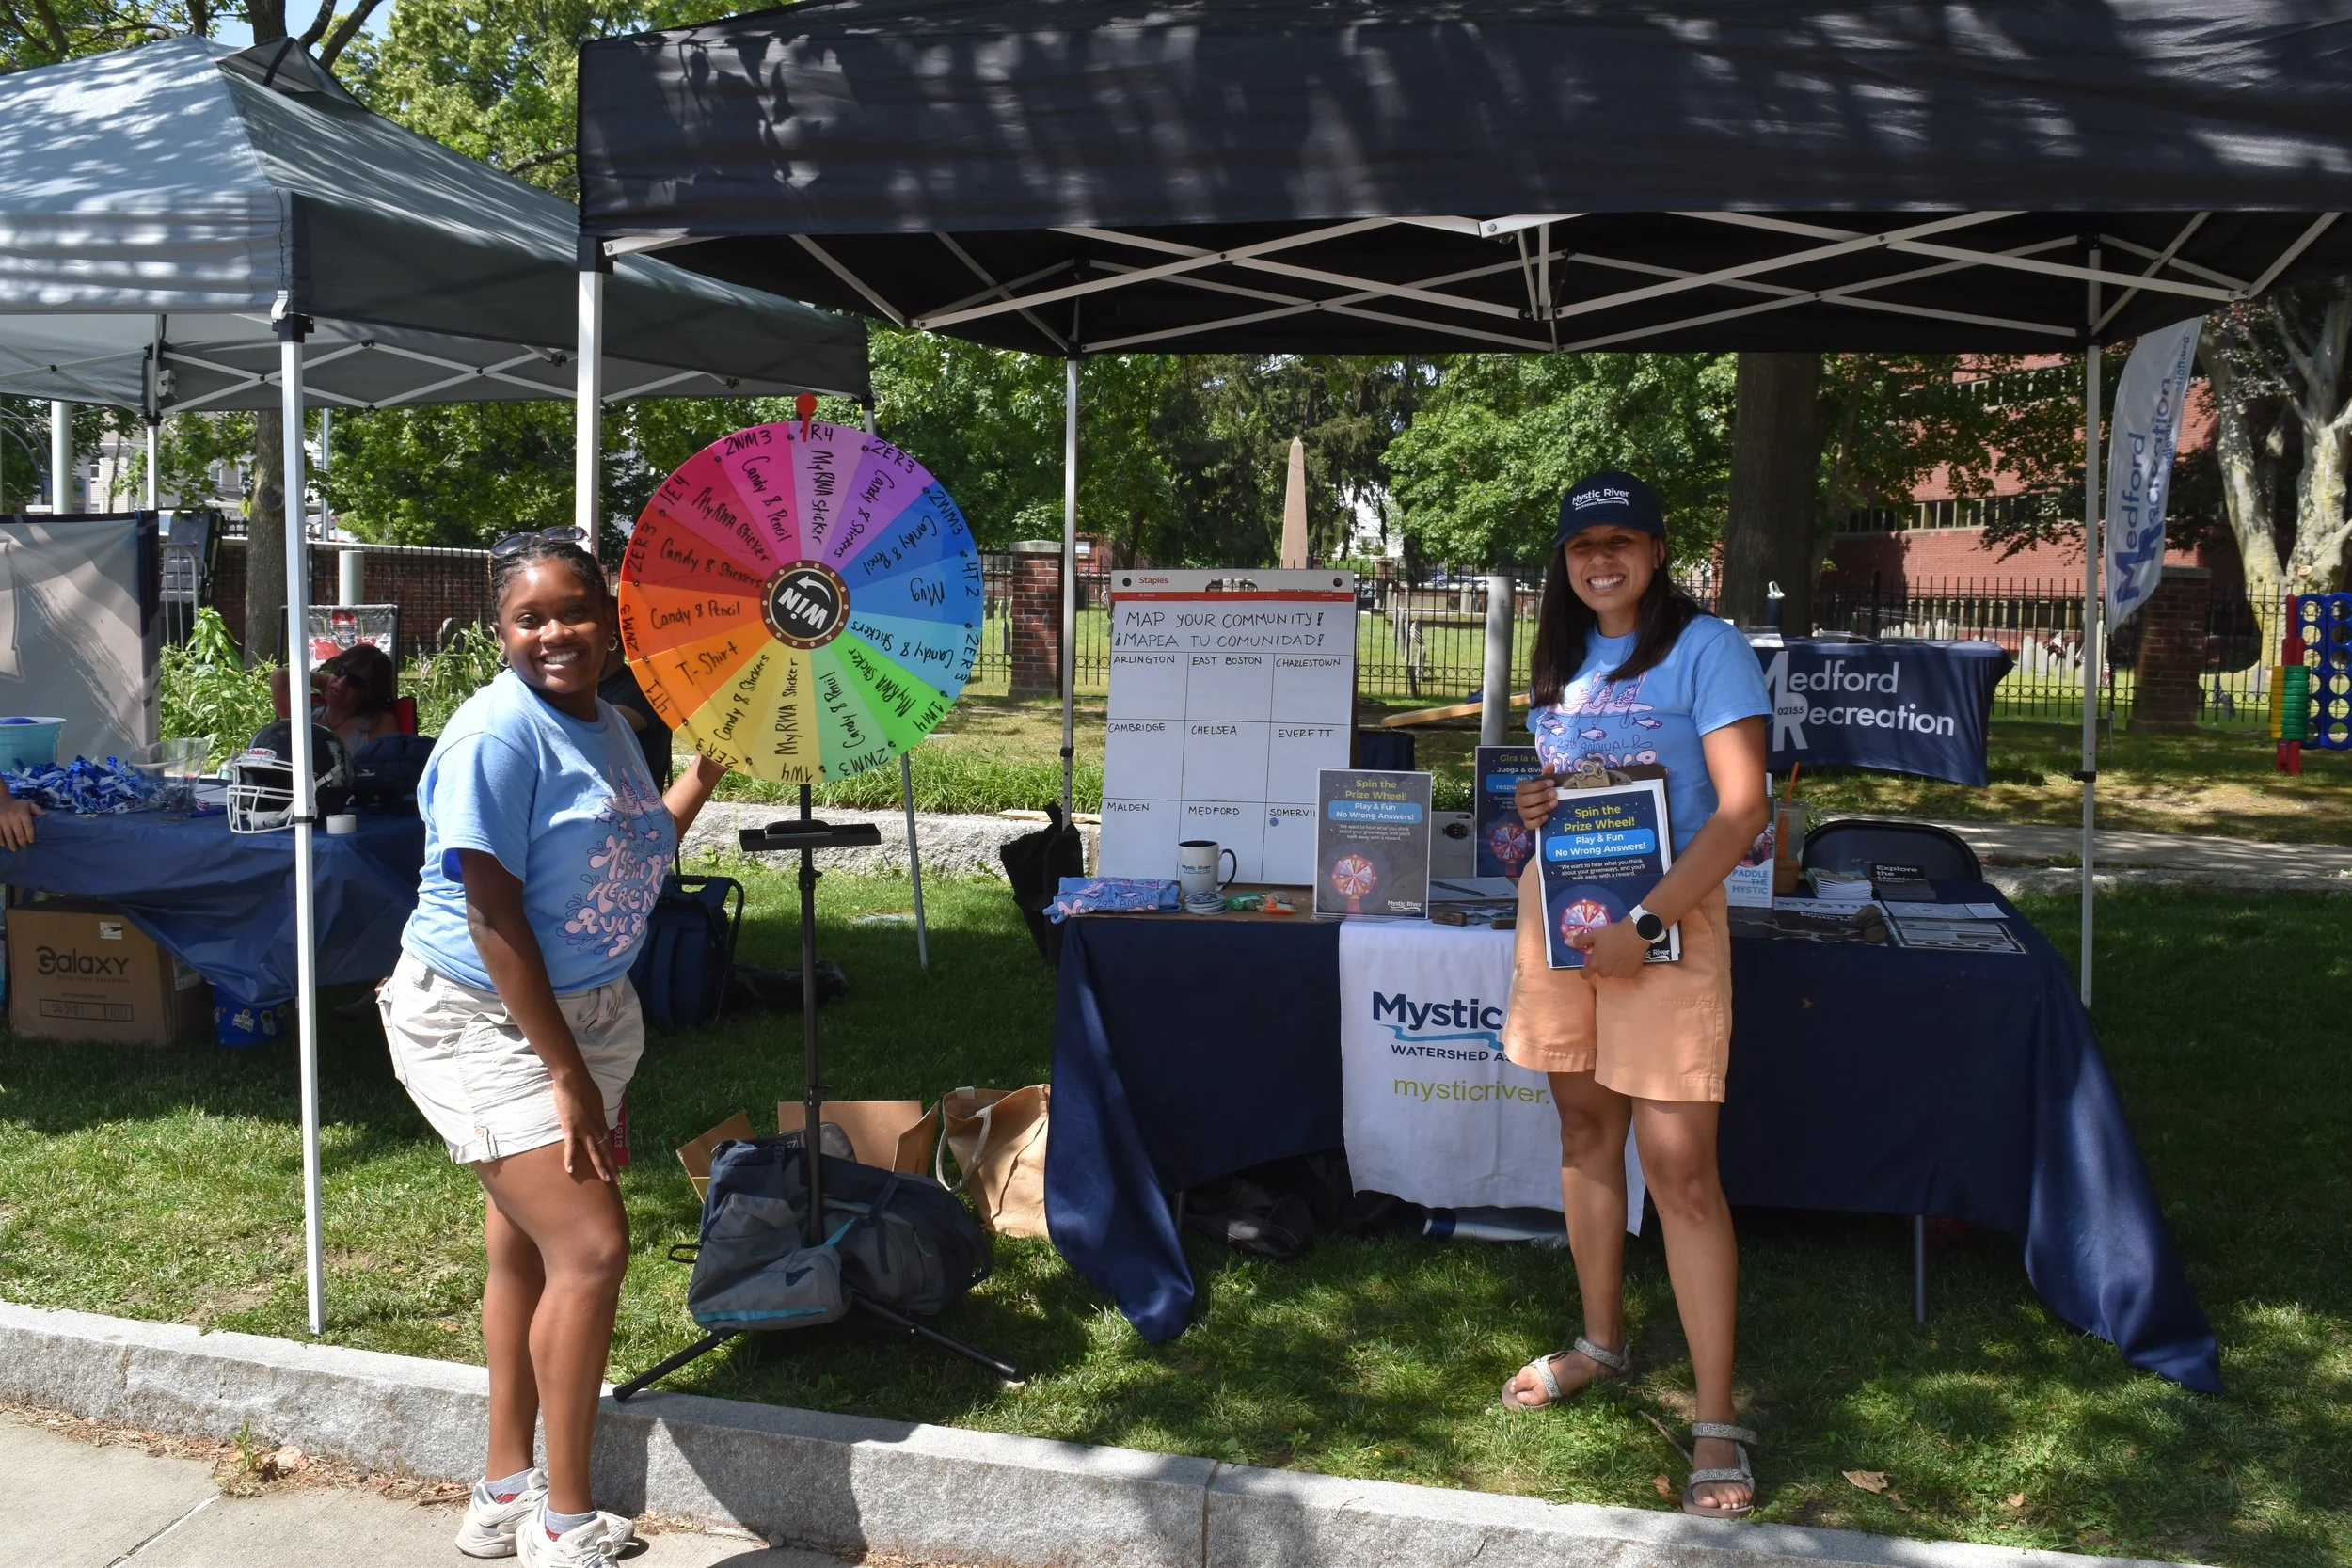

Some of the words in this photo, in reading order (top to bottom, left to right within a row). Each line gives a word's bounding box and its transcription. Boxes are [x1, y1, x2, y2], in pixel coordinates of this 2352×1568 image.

[860, 469, 894, 503] Candy
[742, 456, 770, 493] Candy
[768, 509, 792, 542] Pencil
[1572, 489, 1600, 505] Mystic
[1603, 487, 1629, 497] River
[812, 500, 829, 545] Sticker
[2115, 432, 2145, 603] Medford
[834, 520, 864, 558] Stickers
[899, 515, 937, 548] Candy
[737, 524, 771, 562] Sticker
[660, 538, 699, 573] Candy
[718, 562, 763, 589] Stickers
[863, 551, 891, 576] Pencil
[1139, 577, 1168, 585] Staples
[910, 578, 945, 607] Mug
[651, 608, 691, 629] Candy
[708, 599, 740, 617] Pencil
[1126, 611, 1165, 626] MAP
[1176, 613, 1216, 627] YOUR
[1223, 612, 1324, 628] COMMUNITY!
[851, 621, 894, 651] Stickers
[1115, 632, 1179, 647] ¡MAPEA
[1191, 635, 1210, 647] TU
[1217, 634, 1324, 647] COMUNIDAD!
[914, 641, 954, 669] Candy
[1114, 656, 1175, 664] ARLINGTON
[1192, 657, 1216, 665] EAST
[1226, 657, 1262, 665] BOSTON
[1276, 658, 1341, 667] CHARLESTOWN
[849, 648, 877, 681] Sticker
[782, 657, 799, 697] Sticker
[819, 672, 843, 703] Pencil
[714, 708, 746, 741] Candy
[739, 655, 770, 692] Stickers
[1777, 706, 1804, 716] 02155
[1108, 723, 1165, 733] CAMBRIDGE
[1772, 692, 1954, 752] Recreation
[840, 713, 866, 749] Candy
[1192, 725, 1237, 736] CHELSEA
[1279, 729, 1334, 738] EVERETT
[1557, 737, 1577, 750] 29th
[1580, 738, 1629, 752] ANNUAL
[1356, 780, 1377, 789] Spin
[1345, 790, 1370, 799] Prize
[1373, 791, 1407, 800] Wheel!
[1107, 802, 1150, 812] MALDEN
[1188, 806, 1240, 816] MEDFORD
[1355, 802, 1372, 811] Play
[1575, 808, 1599, 818] Spin
[1601, 805, 1621, 815] the
[1349, 812, 1376, 820] Wrong
[1565, 821, 1592, 832] Prize
[1595, 816, 1635, 829] Wheel!
[1576, 836, 1596, 845] Play
[1597, 834, 1604, 843] &
[1555, 848, 1568, 857] No
[1569, 846, 1601, 856] Wrong
[1604, 842, 1645, 852] Answers!
[1590, 866, 1619, 875] greenways,
[1630, 863, 1645, 872] you'll
[1732, 869, 1769, 879] PADDLE
[1876, 864, 1917, 873] Explore
[1732, 885, 1769, 895] MYSTIC
[1096, 899, 1115, 908] 29th
[1373, 990, 1503, 1031] Mystic
[1391, 1044, 1488, 1061] WATERSHED
